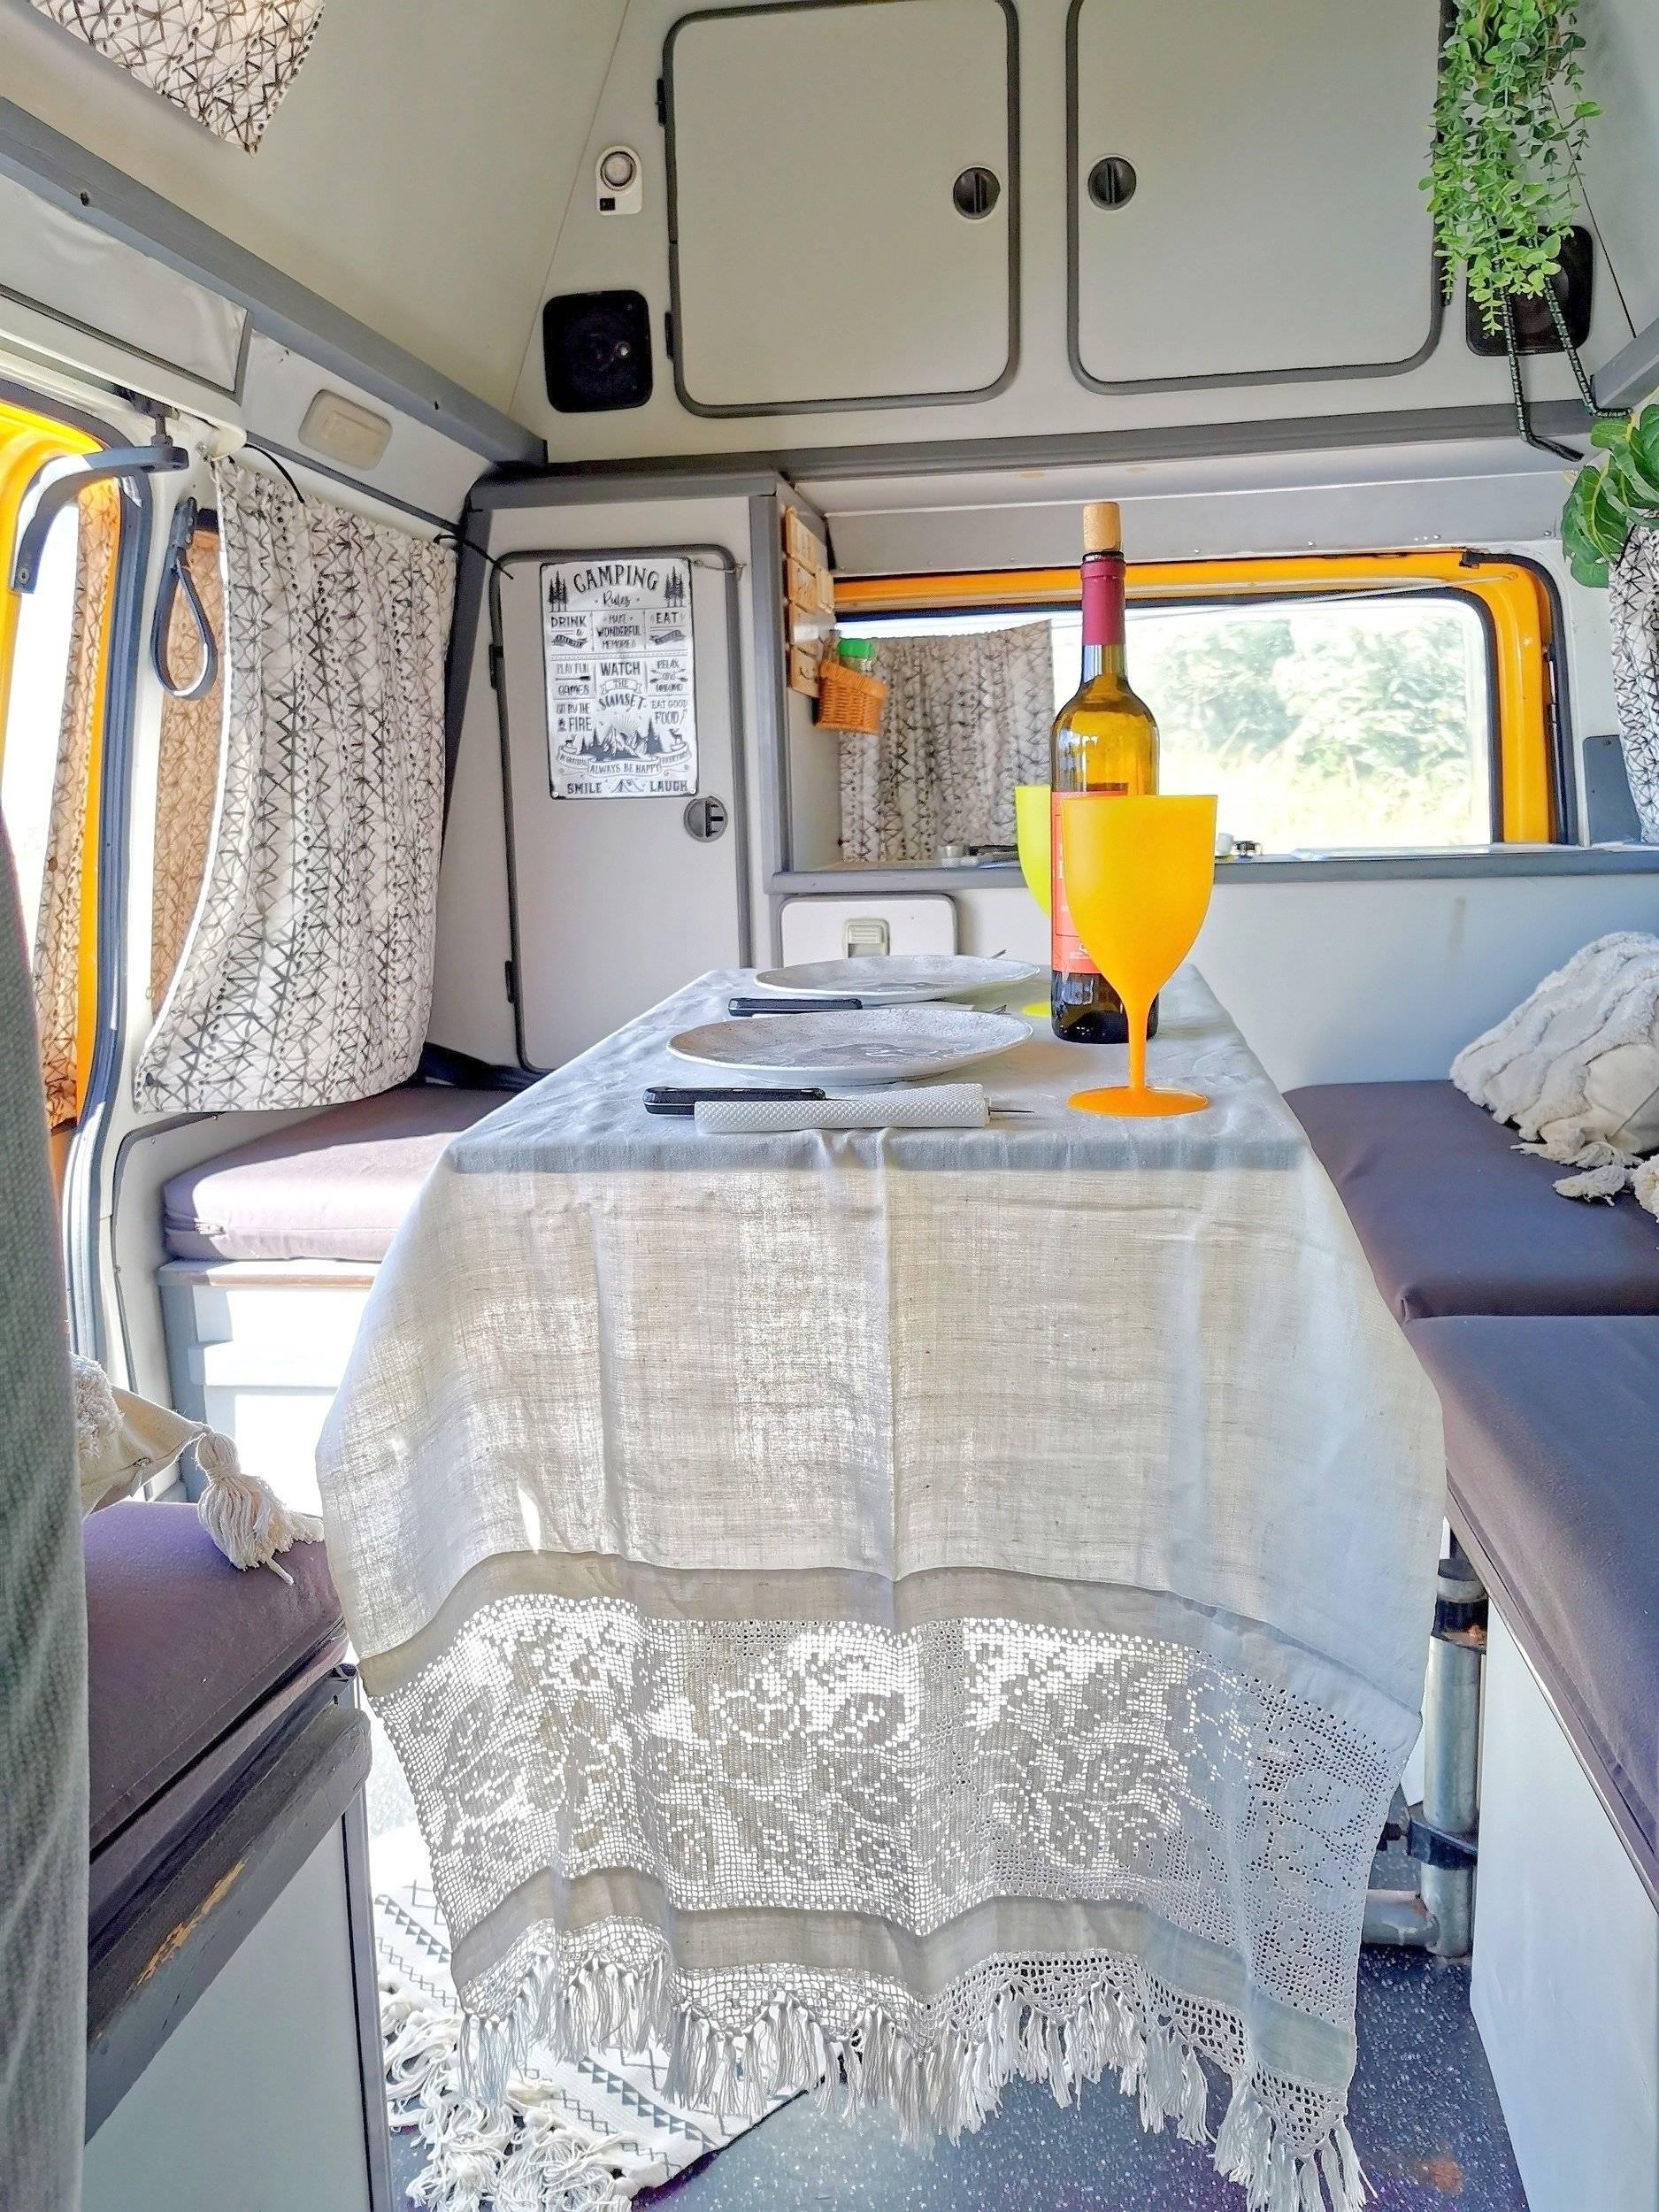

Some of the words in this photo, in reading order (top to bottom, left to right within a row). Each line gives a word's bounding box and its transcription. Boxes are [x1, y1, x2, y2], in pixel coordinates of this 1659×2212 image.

[573, 564, 659, 595] CAMPING
[603, 590, 631, 607] Rules
[550, 616, 588, 628] DRINK
[656, 611, 679, 624] EAT
[601, 661, 641, 676] WATCH
[598, 693, 647, 710] SUNSET
[569, 717, 592, 732] FIRE
[590, 764, 621, 774] ALWAYS
[624, 763, 634, 772] BE
[635, 763, 660, 773] HAPPY
[567, 782, 602, 795] SMILE
[650, 780, 687, 792] LAUGH
